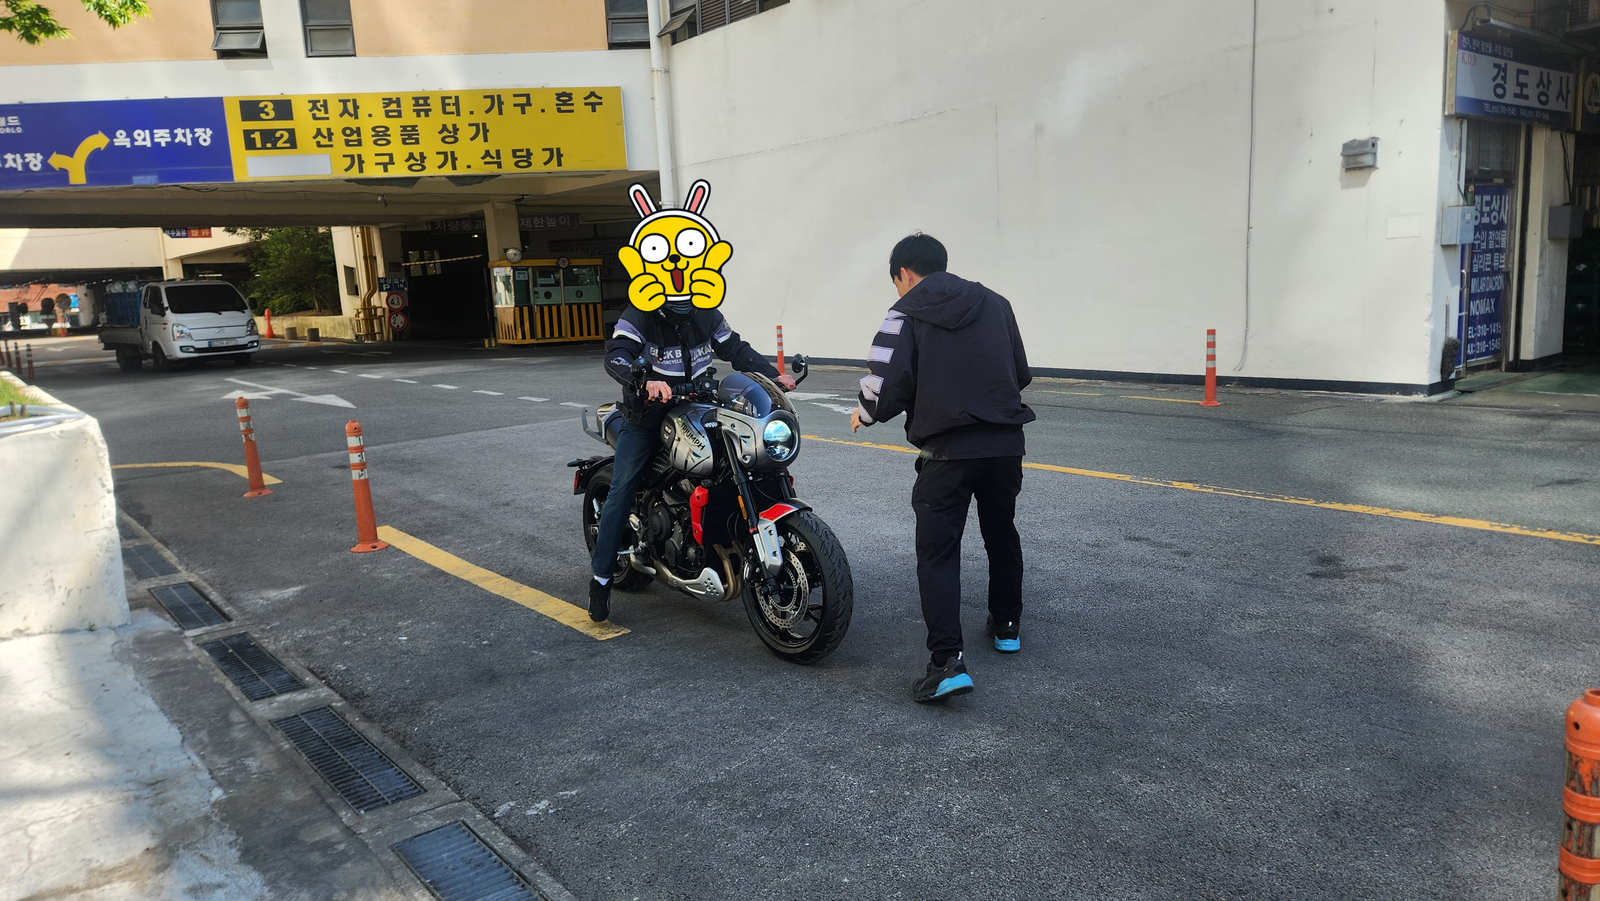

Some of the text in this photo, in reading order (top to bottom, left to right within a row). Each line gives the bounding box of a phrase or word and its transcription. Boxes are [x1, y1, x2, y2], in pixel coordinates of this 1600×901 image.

[1492, 62, 1571, 109] 경도상사
[258, 101, 276, 119] 3
[113, 127, 213, 148] 옥외주차장
[250, 130, 292, 148] 1.2
[312, 122, 490, 149] 산업용품 상가
[0, 152, 44, 172] 차장
[435, 215, 570, 232] 차량통과 제한높이
[1488, 229, 1507, 249] 절연물
[1493, 252, 1506, 270] 튜브
[1470, 297, 1496, 317] NOMAX
[681, 421, 706, 451] TRIUMPH
